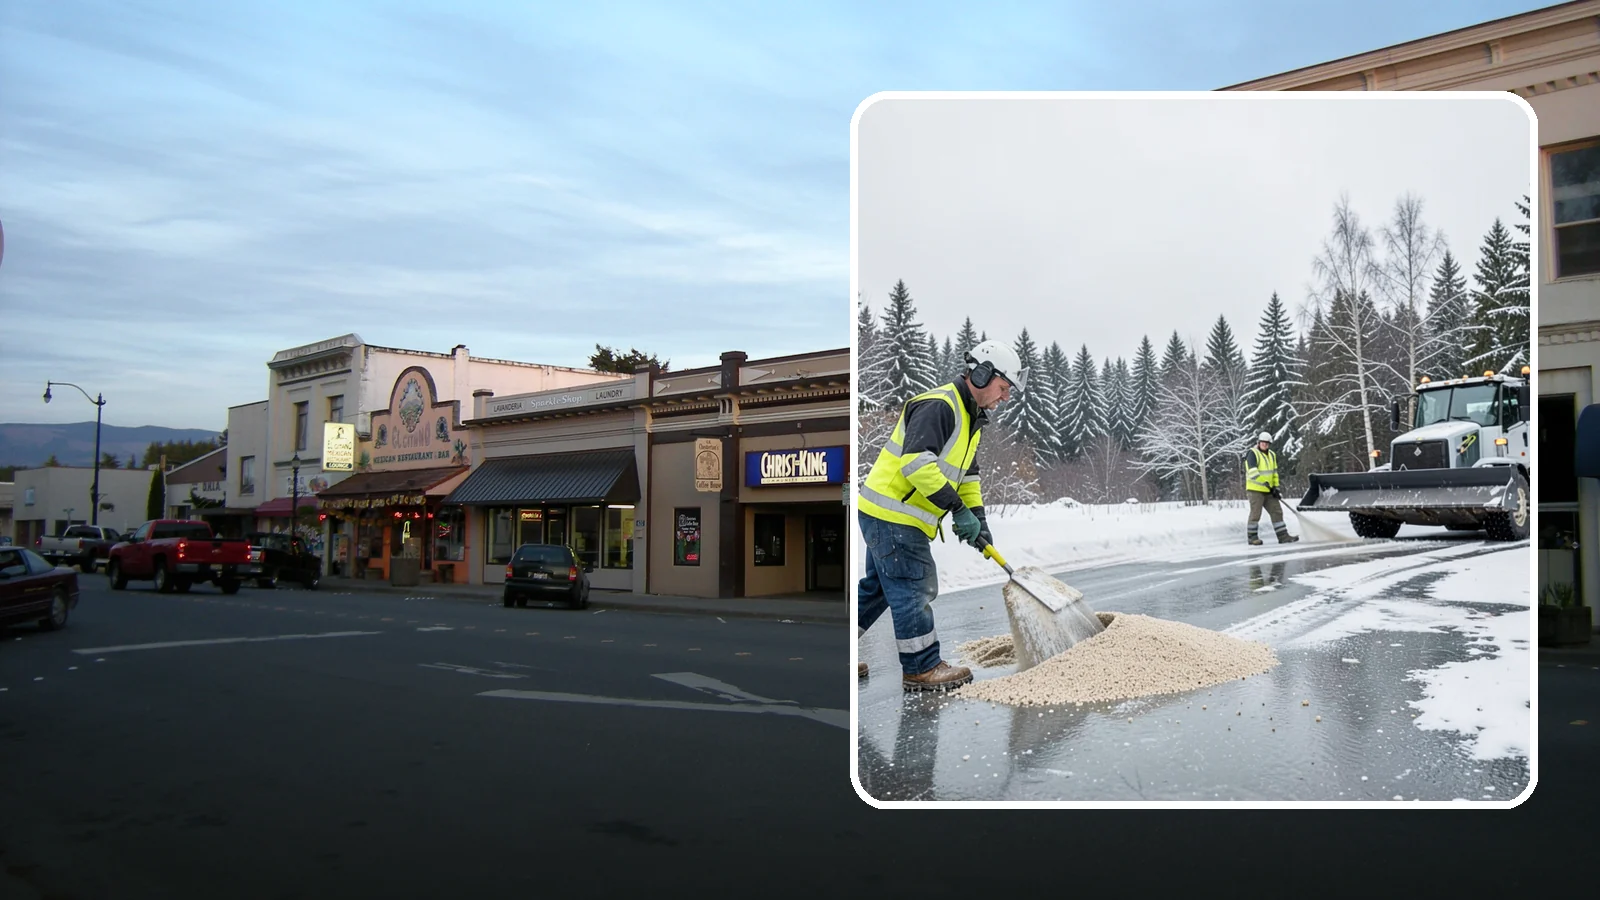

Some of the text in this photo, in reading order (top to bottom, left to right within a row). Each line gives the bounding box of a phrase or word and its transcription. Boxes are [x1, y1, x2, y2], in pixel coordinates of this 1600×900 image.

[595, 388, 623, 400] LAUNDRY
[493, 402, 522, 413] LAVANDERIA
[530, 394, 582, 409] Sparkle Shop
[373, 455, 398, 464] MEXICAN
[397, 451, 433, 462] RESTAURANT
[437, 450, 450, 459] BAR
[761, 450, 827, 478] CHRIST KING
[696, 480, 709, 488] Coffee
